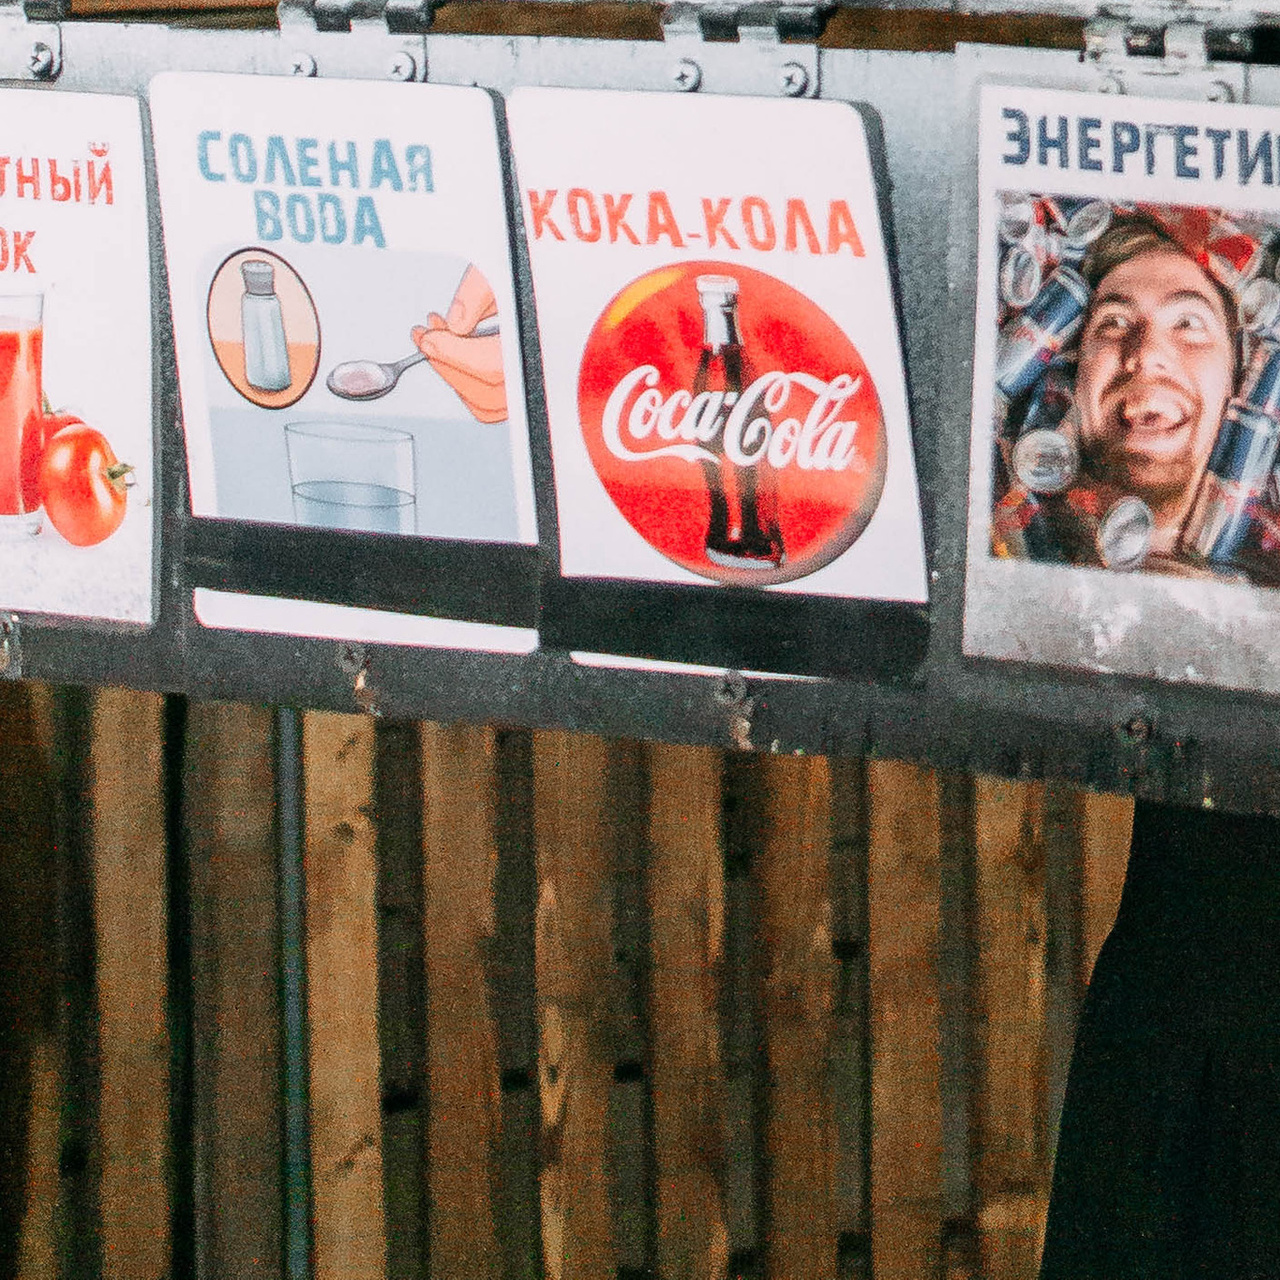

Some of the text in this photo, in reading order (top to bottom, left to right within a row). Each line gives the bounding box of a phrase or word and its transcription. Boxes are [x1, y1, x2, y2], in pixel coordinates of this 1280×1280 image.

[196, 129, 435, 194] СОЛЕНАЯ
[253, 189, 388, 249] ВОДА
[527, 187, 867, 258] КОКА-КОЛА
[602, 364, 864, 471] Coca-Cola
